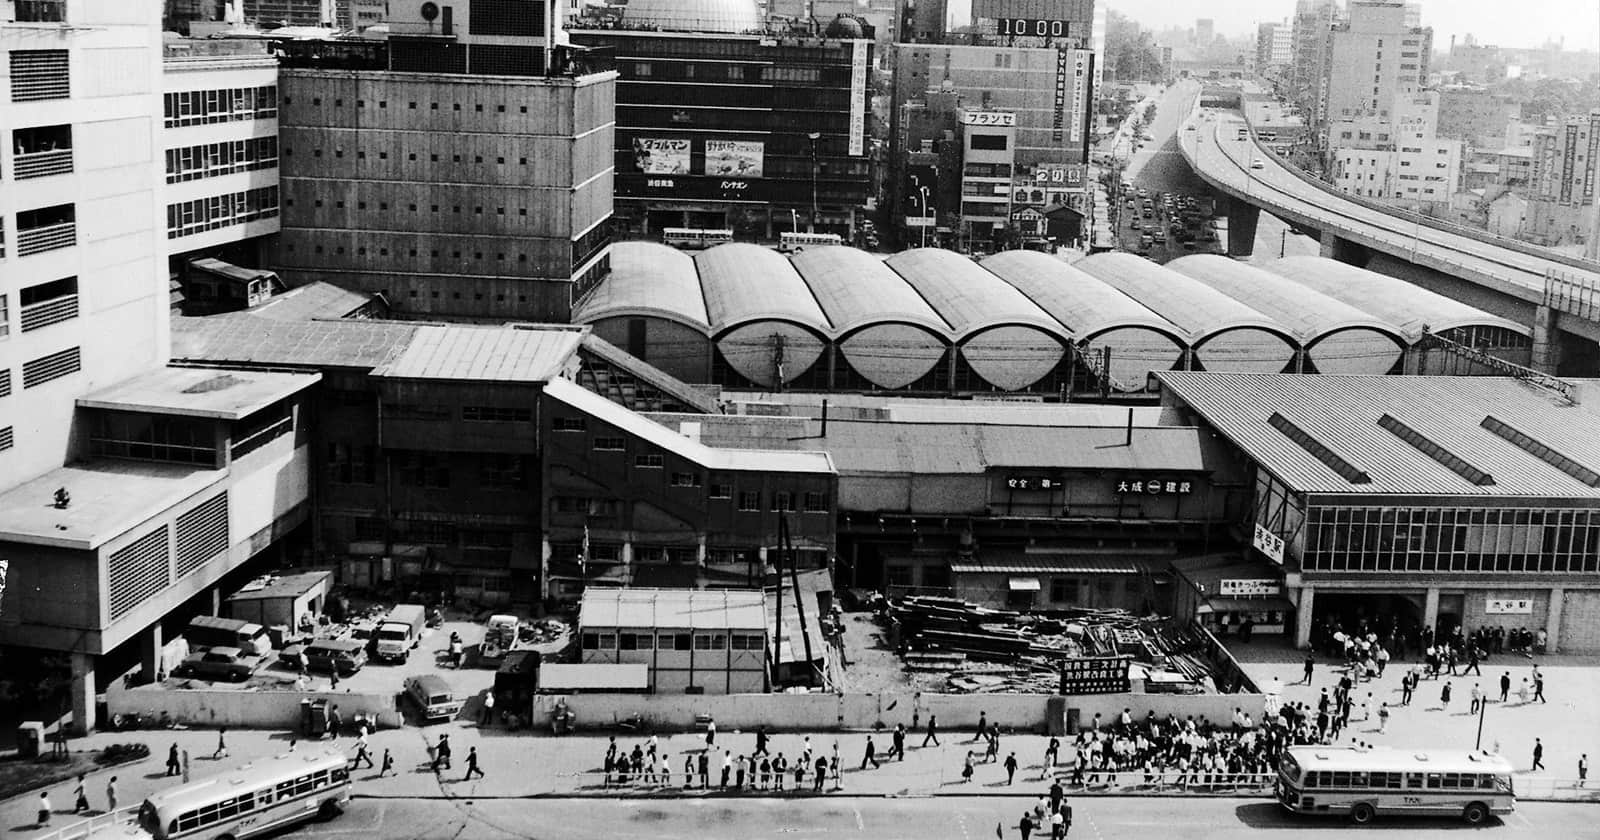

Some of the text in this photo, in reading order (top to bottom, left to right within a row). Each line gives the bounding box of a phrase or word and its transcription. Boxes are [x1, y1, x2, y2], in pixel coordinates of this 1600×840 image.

[1004, 19, 1062, 36] 10 00
[968, 114, 1013, 125] フランセ
